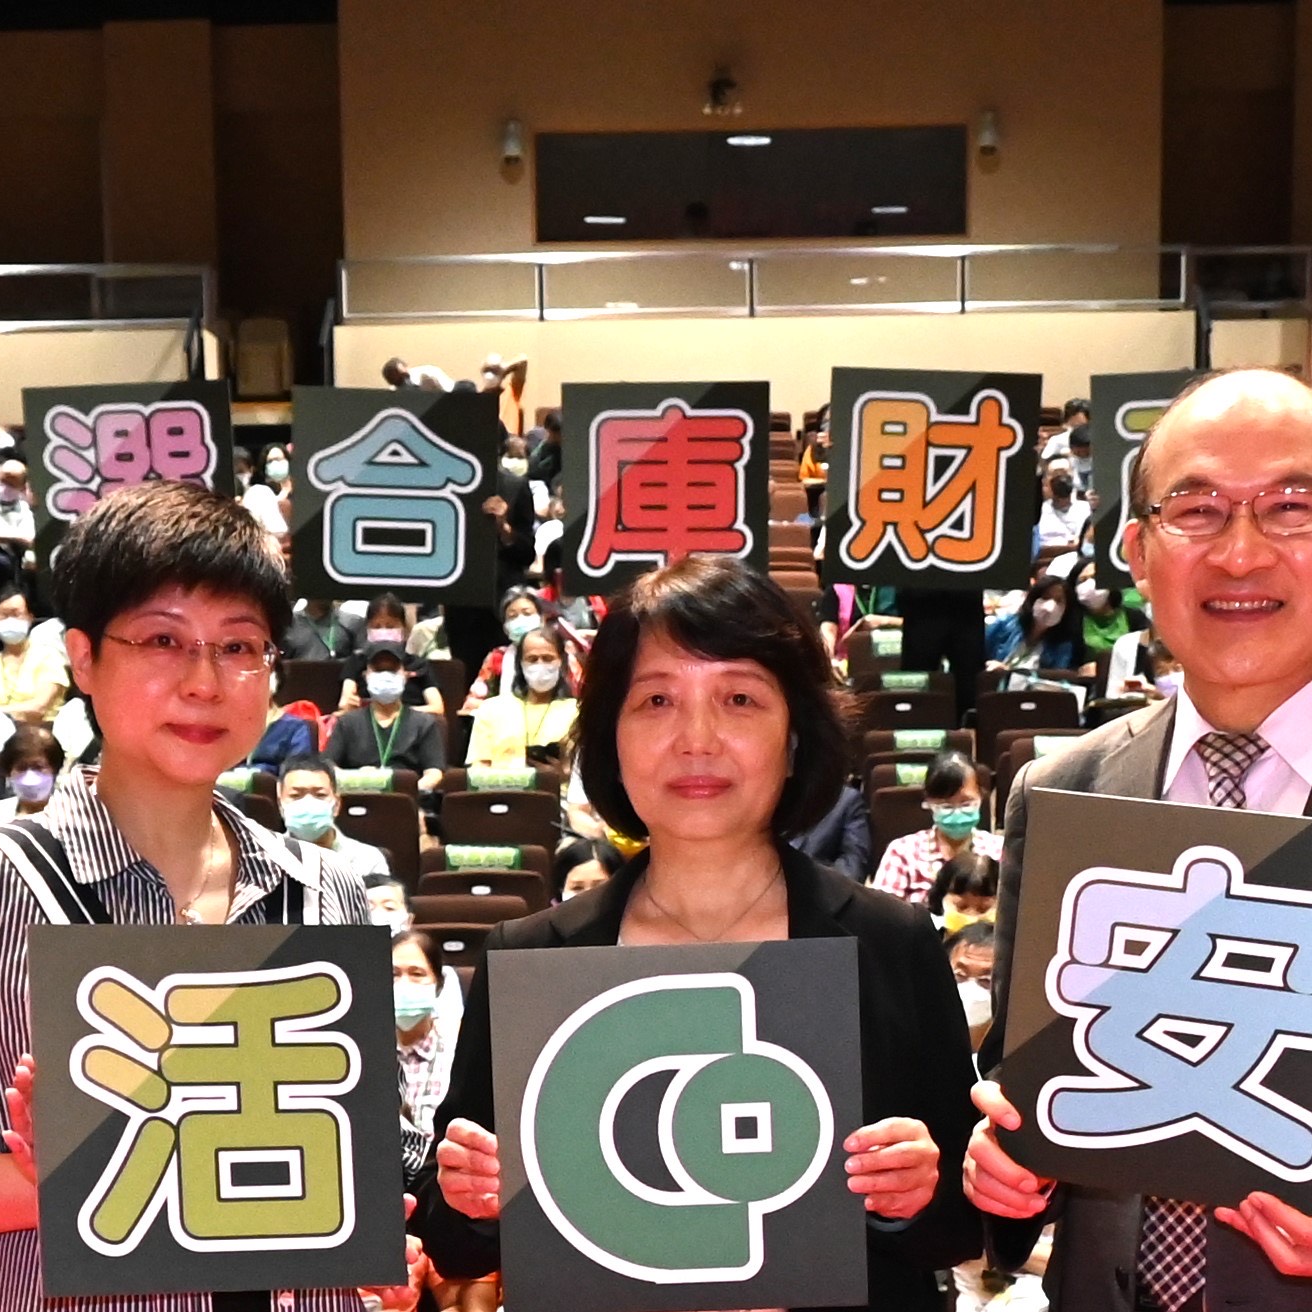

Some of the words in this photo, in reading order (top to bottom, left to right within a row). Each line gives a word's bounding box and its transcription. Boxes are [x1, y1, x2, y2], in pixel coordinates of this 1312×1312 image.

[307, 407, 482, 587] 合
[577, 397, 754, 577] 庫
[839, 389, 1024, 572] 財
[69, 961, 362, 1257] 活
